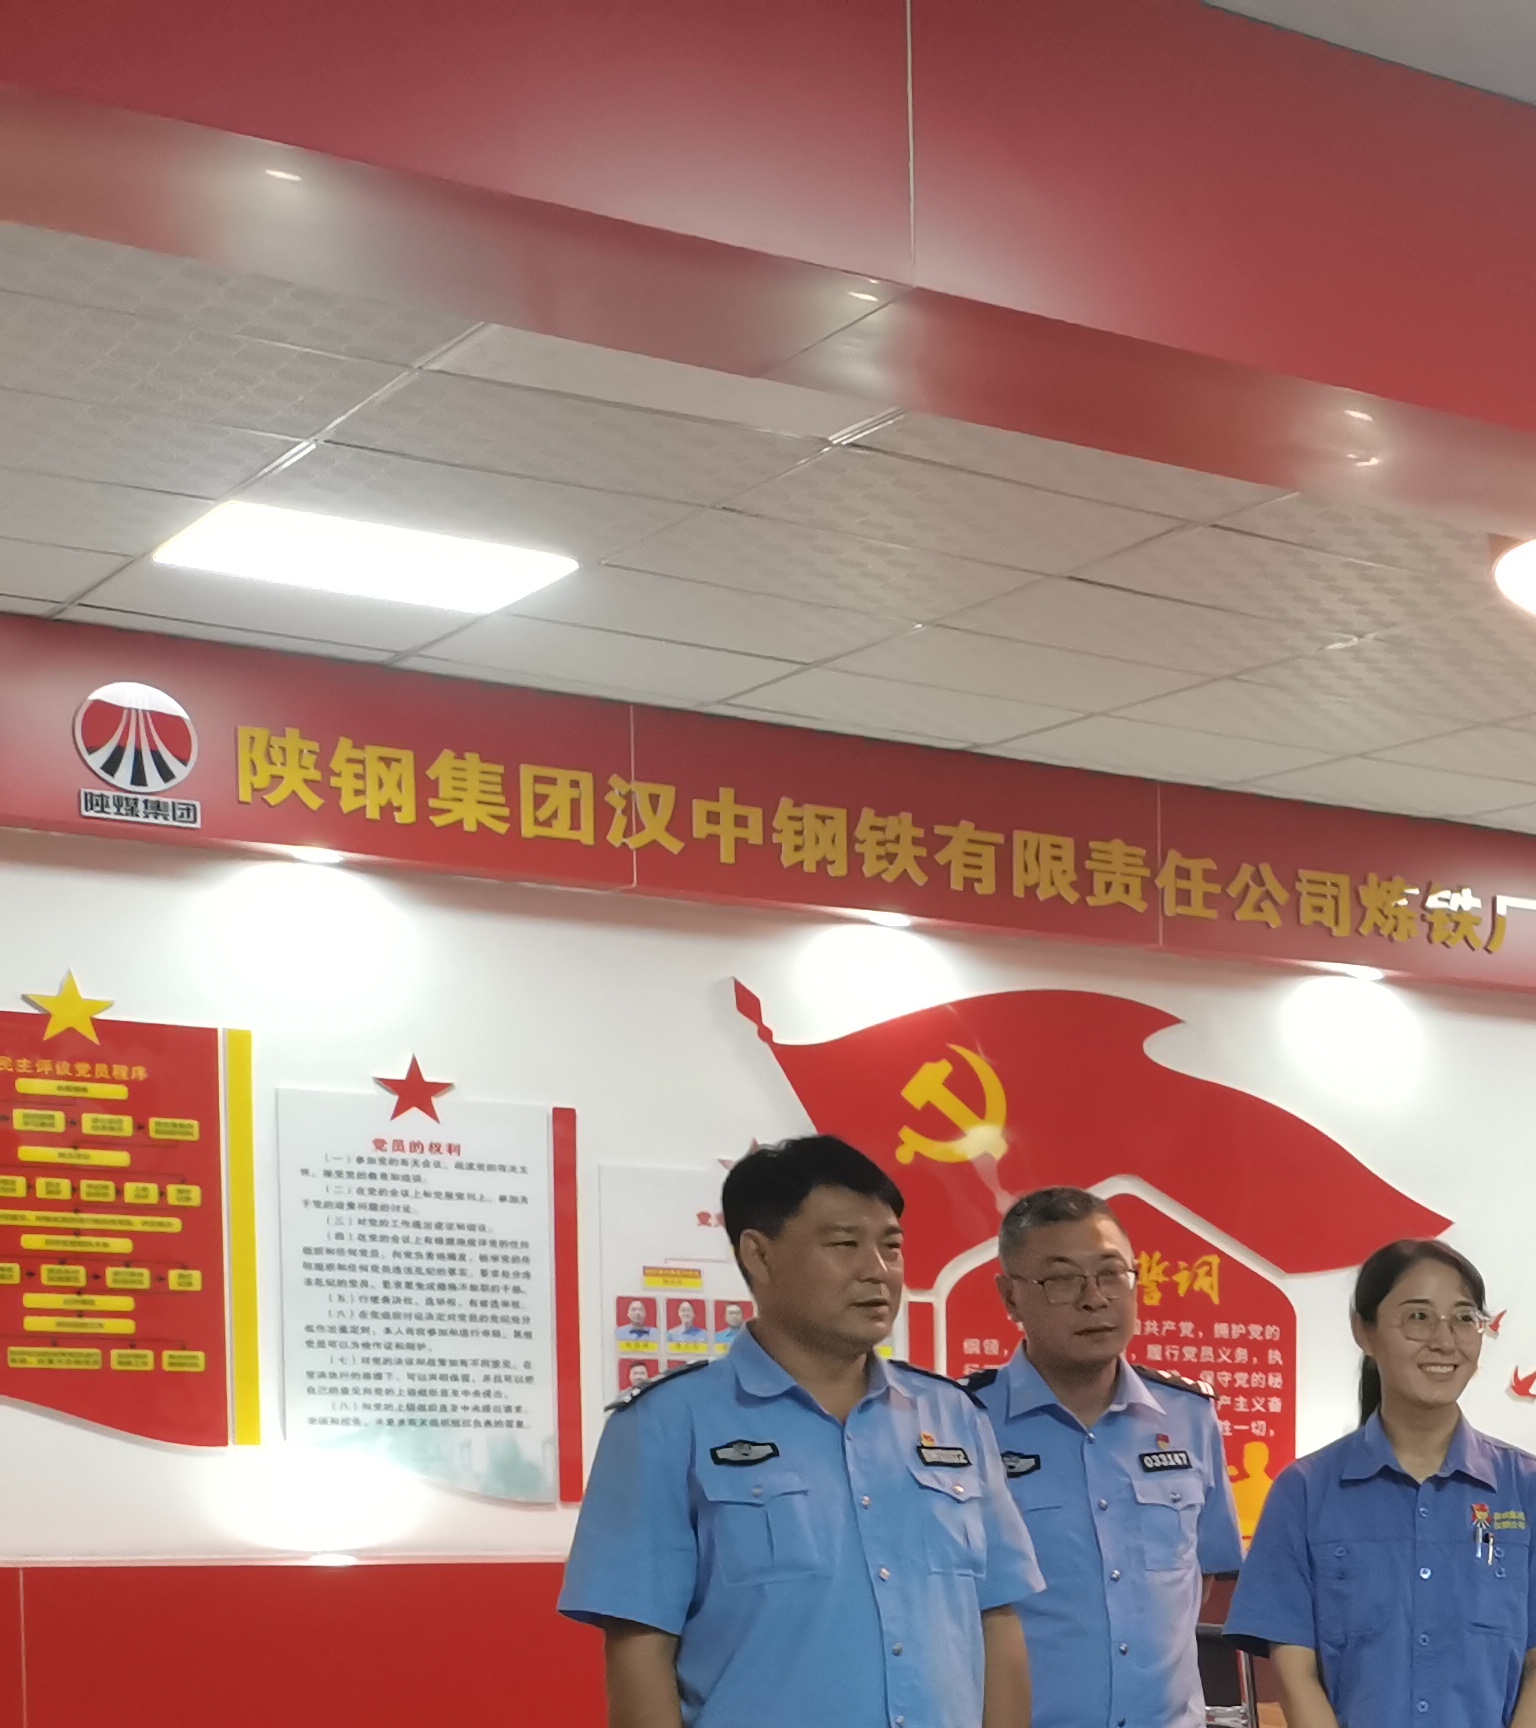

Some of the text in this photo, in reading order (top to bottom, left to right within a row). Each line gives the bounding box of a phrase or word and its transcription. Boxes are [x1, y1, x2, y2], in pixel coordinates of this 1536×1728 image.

[84, 791, 198, 824] 陕煤集团
[372, 1137, 461, 1157] 党员的权利
